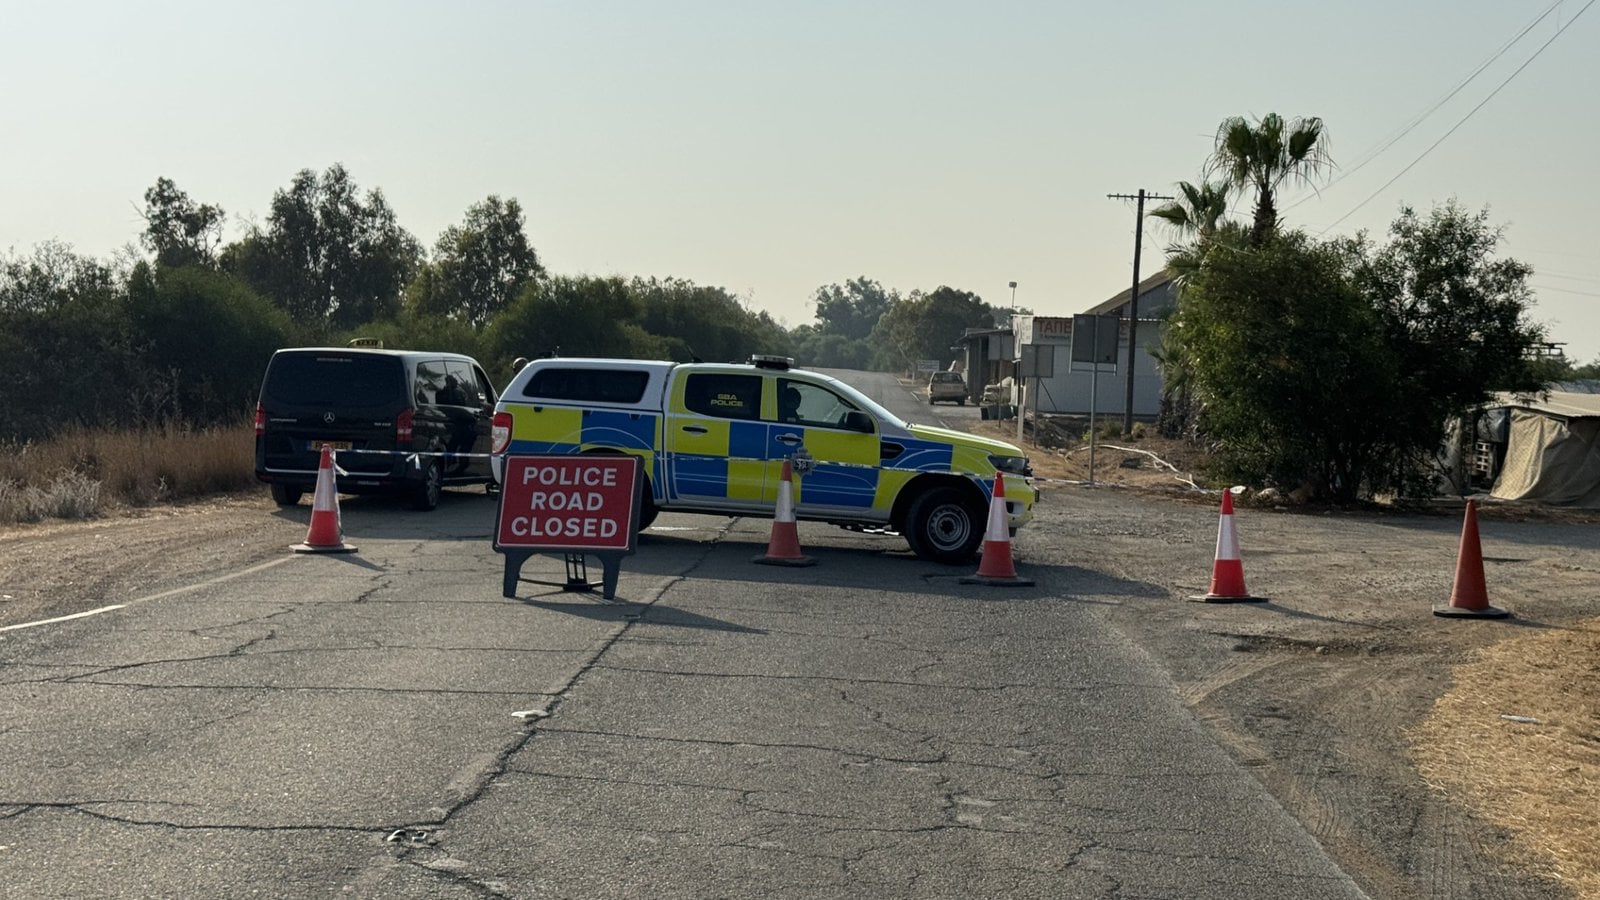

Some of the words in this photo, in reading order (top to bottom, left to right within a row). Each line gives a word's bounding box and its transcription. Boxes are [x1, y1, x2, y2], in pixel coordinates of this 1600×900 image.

[710, 399, 744, 407] POLICE
[717, 393, 738, 401] SBA
[522, 466, 618, 487] POLICE
[530, 491, 604, 511] ROAD
[510, 516, 618, 538] CLOSED
